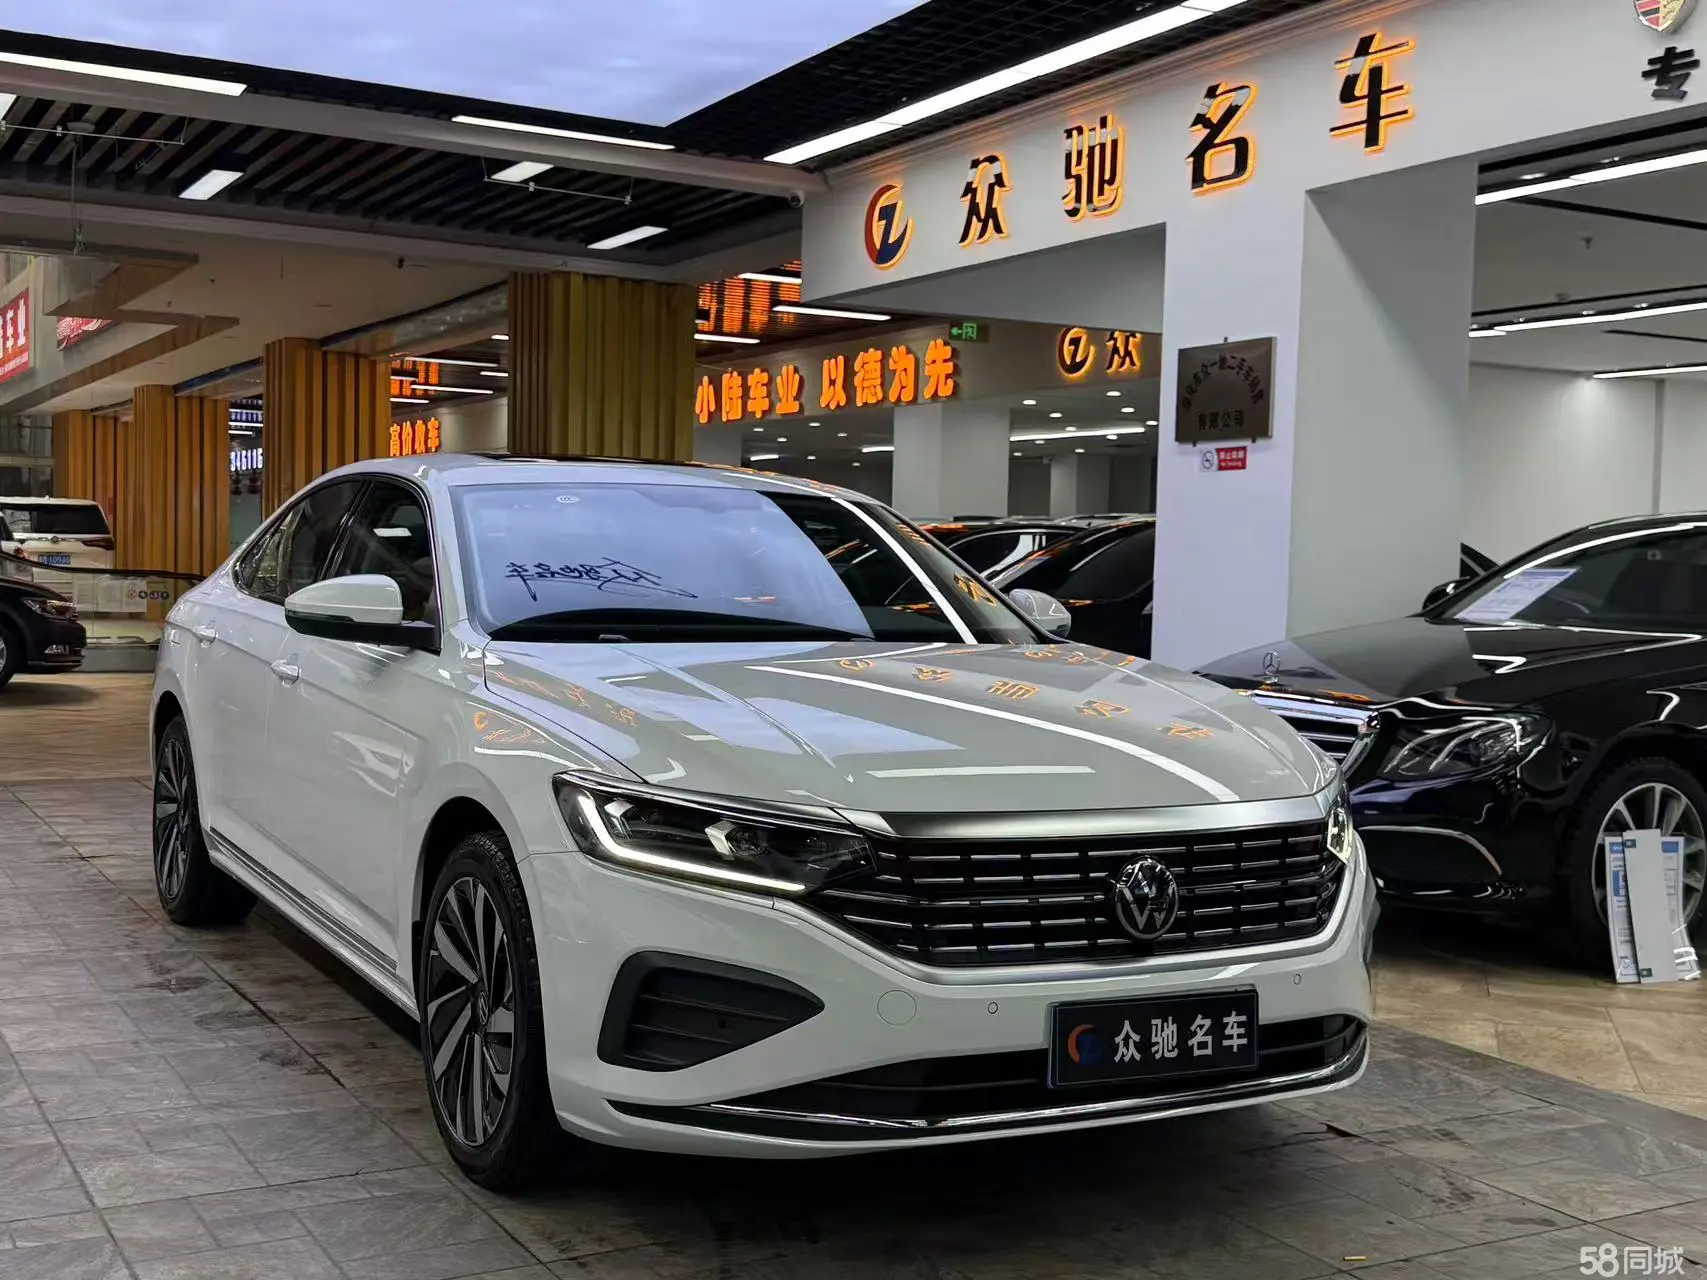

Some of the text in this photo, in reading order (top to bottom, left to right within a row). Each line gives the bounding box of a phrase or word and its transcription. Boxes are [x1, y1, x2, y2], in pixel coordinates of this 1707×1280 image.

[1641, 46, 1701, 101] 专
[958, 30, 1415, 248] 众驰名车
[695, 338, 955, 424] 小陆车业 以德为先
[390, 416, 440, 457] 高价收车
[1113, 1010, 1249, 1064] 众驰名车
